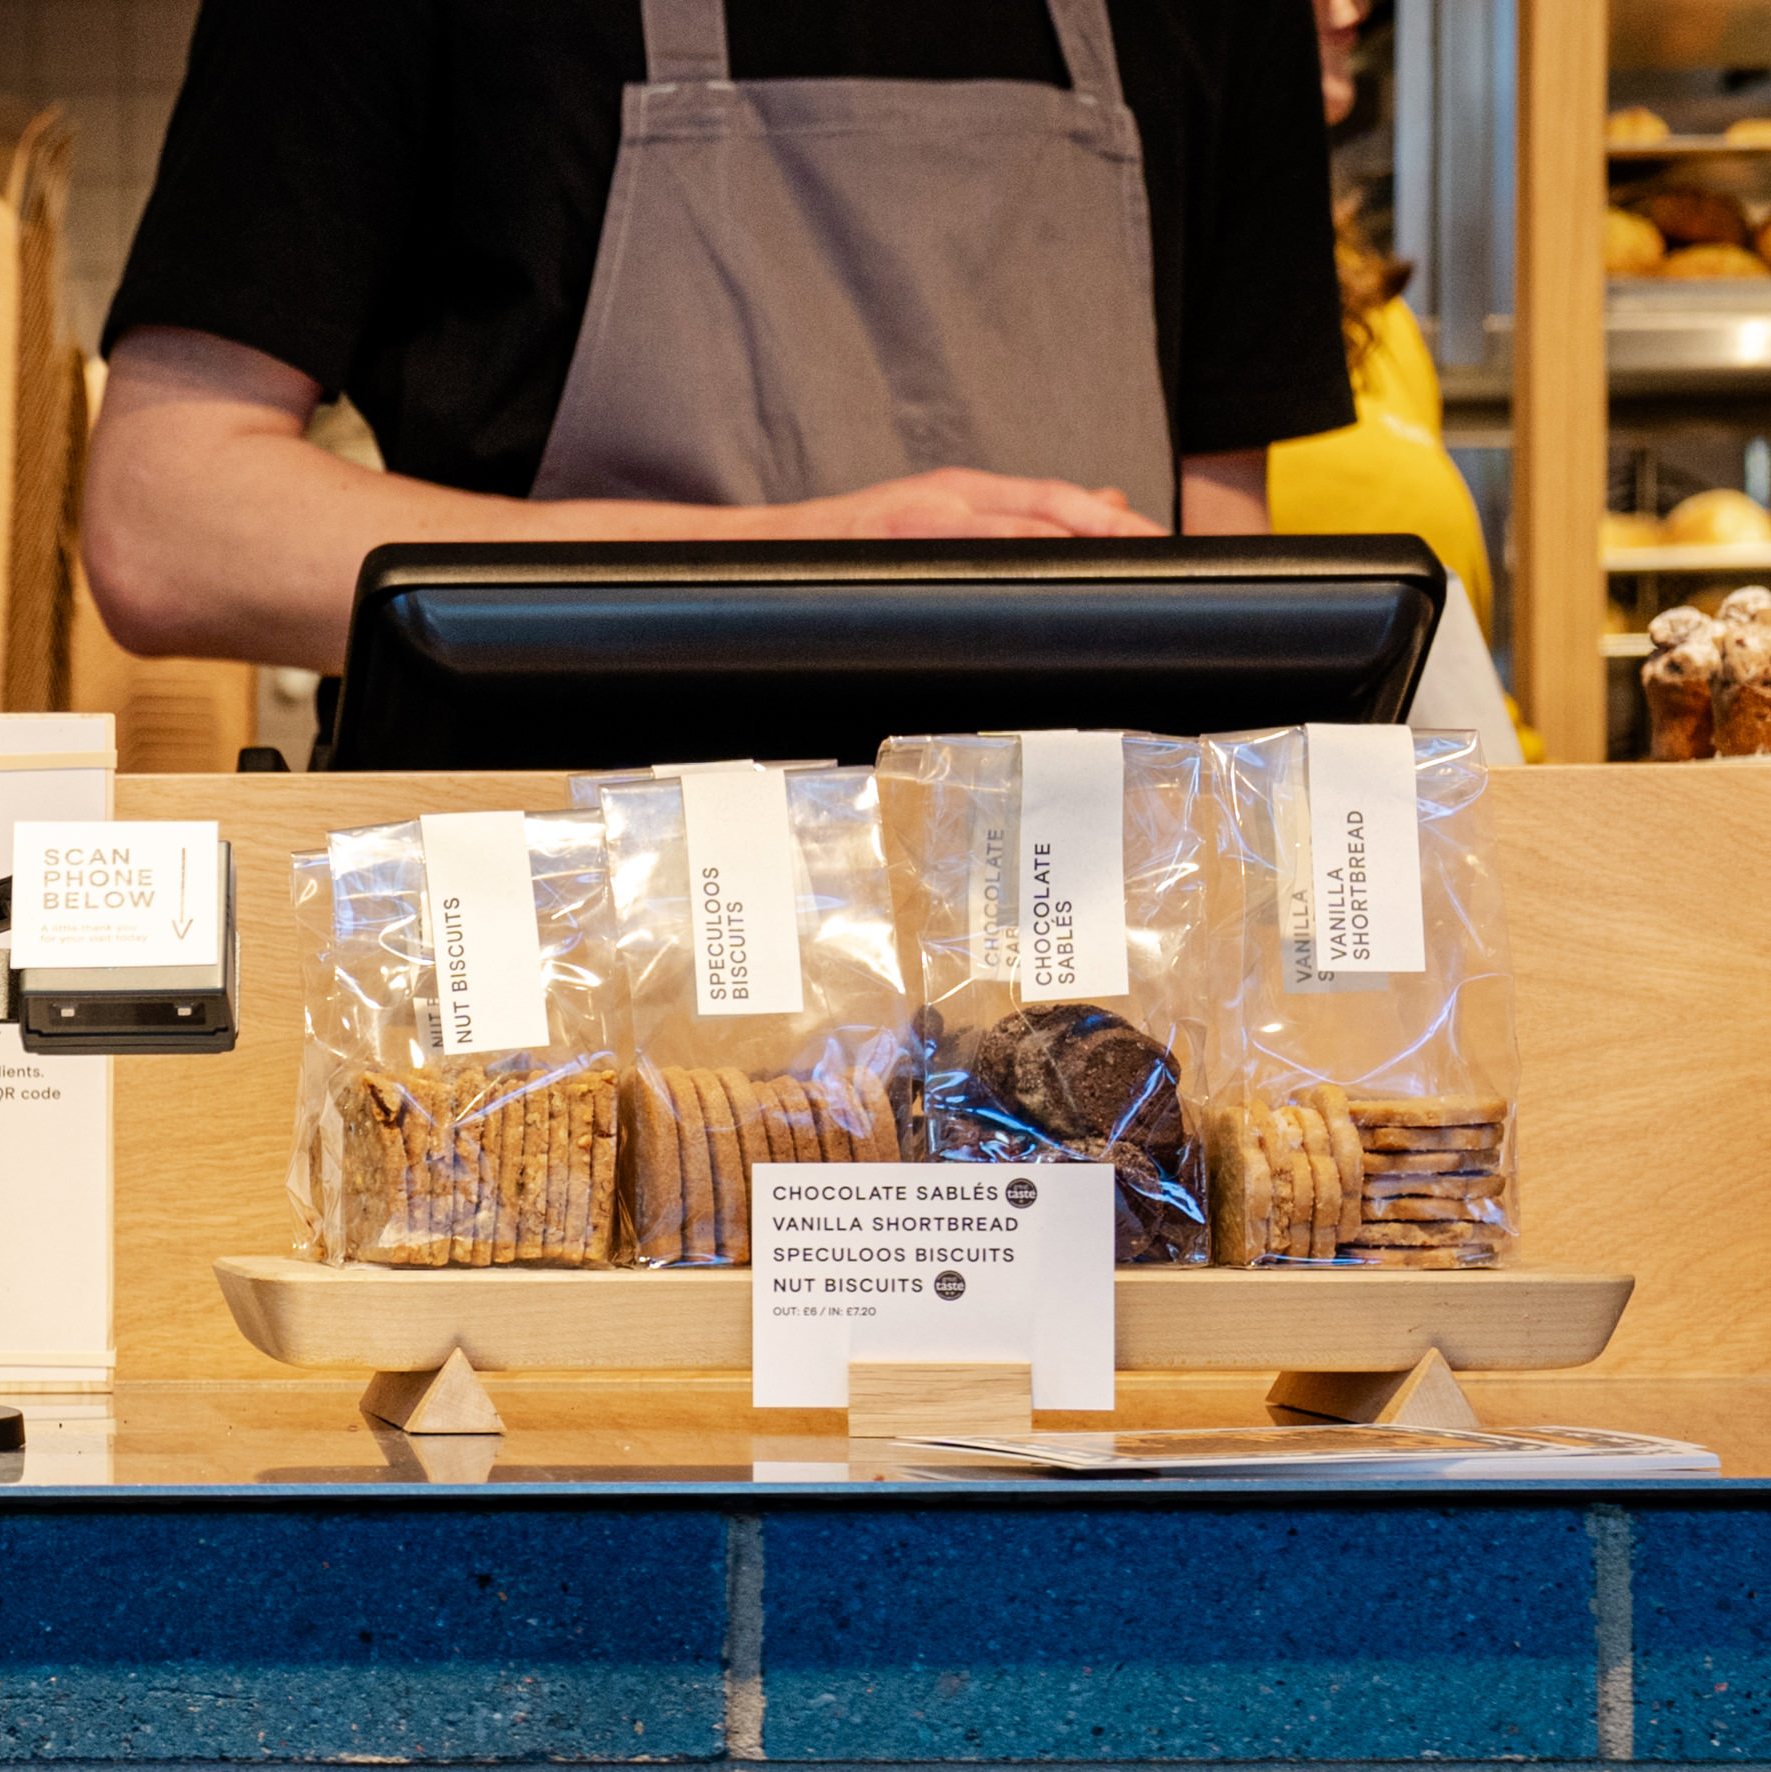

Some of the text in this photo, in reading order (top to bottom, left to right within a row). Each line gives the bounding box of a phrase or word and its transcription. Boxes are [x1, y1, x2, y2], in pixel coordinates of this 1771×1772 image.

[43, 848, 130, 866] SCAN
[43, 869, 153, 887] PHONE
[43, 890, 156, 910] BELOW
[984, 828, 1004, 967] CHOCOLATE
[1347, 810, 1370, 960] SHORTBREAD
[702, 867, 727, 1000] SPECULOOS
[1033, 843, 1053, 986] CHOCOLATE
[1292, 889, 1313, 984] VANILLA
[1327, 867, 1347, 961] VANILLA
[726, 901, 749, 1000] BISCUITS
[1051, 900, 1075, 984] SABLÉS
[443, 897, 473, 1044] NUT BISCUITS
[21, 1087, 61, 1100] code
[773, 1186, 907, 1201] CHOCOLATE
[916, 1182, 999, 1200] SABLÉS
[773, 1216, 1019, 1231] VANILLA SHORTBREAD
[773, 1247, 1015, 1262] SPECULOOS BISCUITS
[772, 1306, 877, 1316] OUT: £6 / IN: £7.20
[773, 1278, 816, 1293] NUT
[825, 1278, 924, 1293] BISCUITS
